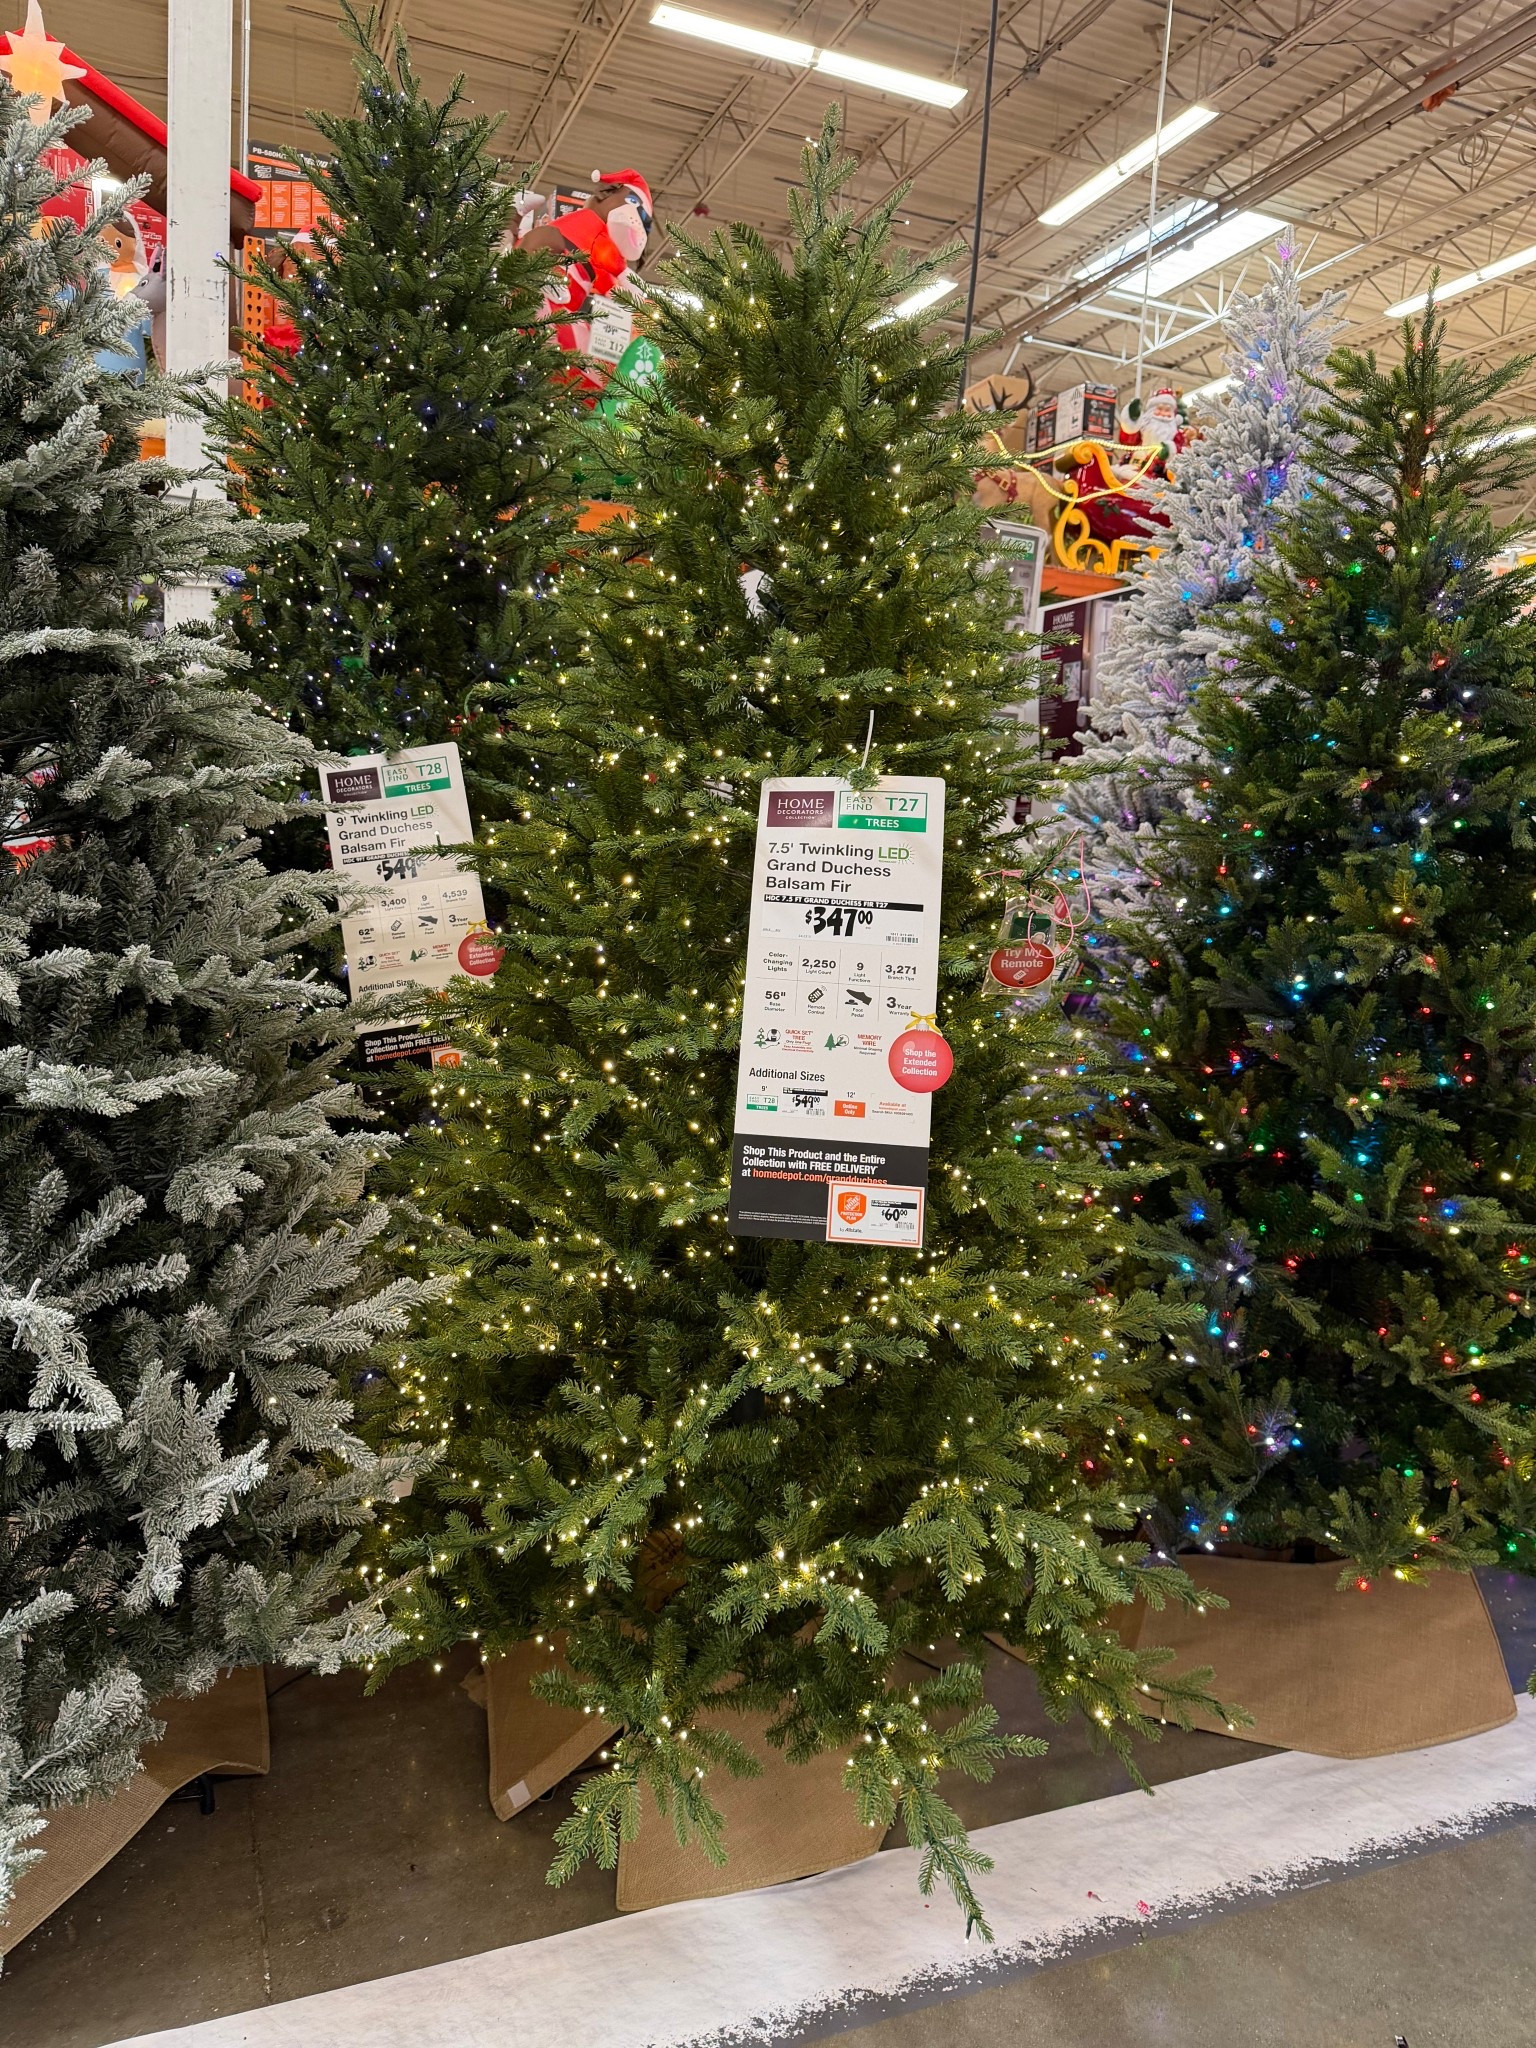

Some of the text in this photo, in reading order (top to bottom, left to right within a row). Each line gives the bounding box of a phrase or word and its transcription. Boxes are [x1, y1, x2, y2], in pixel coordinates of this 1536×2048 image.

[387, 767, 408, 776] EASY
[416, 763, 442, 777] T28
[334, 774, 372, 788] HOME
[388, 774, 409, 782] FIND
[336, 784, 373, 793] DECORATORS
[405, 782, 431, 793] TREES
[778, 798, 825, 809] HOME
[846, 796, 874, 804] EASY
[885, 797, 919, 812] T27
[846, 803, 873, 811] FIND
[350, 810, 408, 825] Twinkling
[411, 804, 434, 817] LED
[865, 818, 900, 828] TREES
[339, 821, 433, 841] Grand Duchess
[340, 837, 406, 855] Balsam Fir
[768, 842, 910, 861] 7.5' Twinkling LED
[767, 859, 891, 877] Grand Duchess
[766, 876, 852, 893] Balsam Fir
[442, 889, 468, 899] 4,539
[381, 898, 407, 907] 3,400
[804, 897, 829, 905] GRAND
[831, 899, 862, 907] DUCHESS
[448, 914, 456, 923] 3
[1004, 947, 1042, 959] Try My
[763, 958, 793, 966] Changing
[802, 958, 836, 969] 2,250
[856, 962, 864, 971] 9
[1000, 959, 1044, 968] Remote
[885, 964, 917, 975] 3,271
[358, 980, 395, 993] Additional
[886, 996, 897, 1009] 3
[364, 1039, 382, 1048] Shop
[383, 1035, 397, 1045] This
[365, 1044, 398, 1055] Collection
[399, 1040, 414, 1050] with
[415, 1037, 432, 1047] FREE
[905, 1049, 937, 1058] Shop the
[903, 1058, 937, 1067] Extended
[749, 1067, 826, 1082] Additional Sizes
[902, 1067, 938, 1076] Collection
[743, 1145, 886, 1165] Shop This Product and the Entire
[742, 1157, 786, 1169] Collection
[788, 1159, 808, 1170] with
[809, 1161, 832, 1172] FREE
[741, 1168, 751, 1177] at
